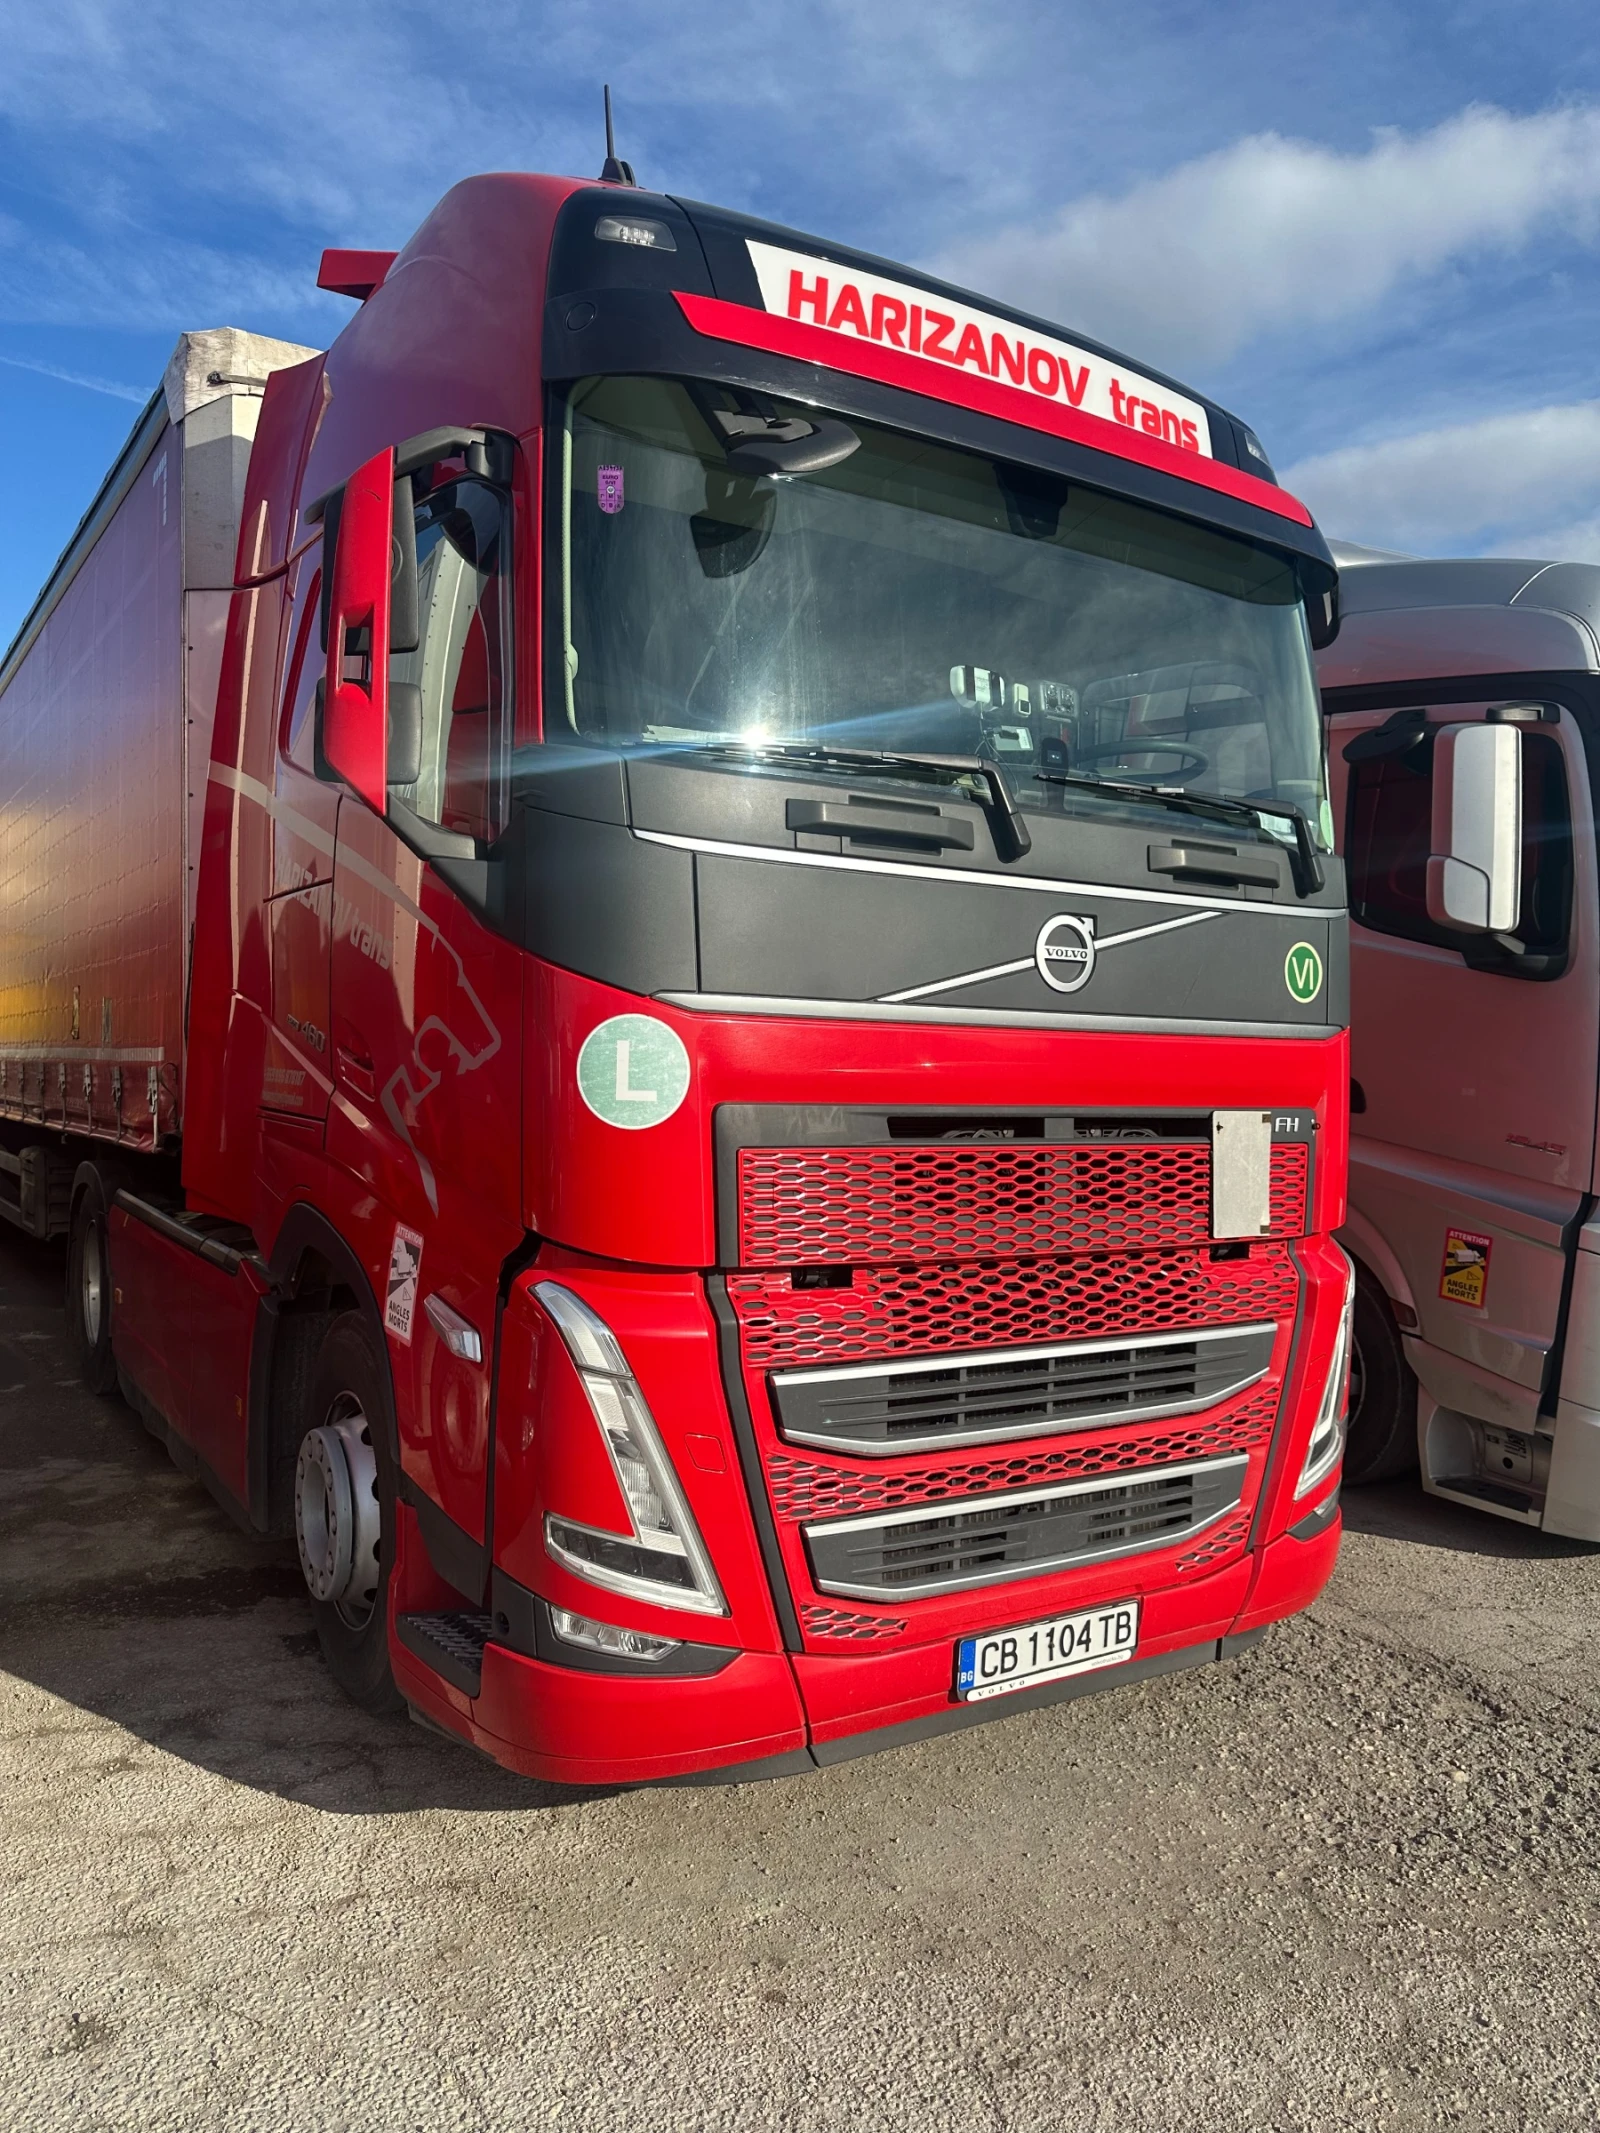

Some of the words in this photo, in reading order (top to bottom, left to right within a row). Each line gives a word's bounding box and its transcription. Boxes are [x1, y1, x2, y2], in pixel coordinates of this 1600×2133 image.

[787, 269, 1090, 406] HARIZANOV
[1109, 378, 1198, 452] trans
[350, 907, 393, 970] trans
[1045, 947, 1088, 959] VOLVO
[1291, 956, 1314, 991] VI
[301, 1020, 326, 1053] 460
[615, 1040, 657, 1101] L
[1275, 1117, 1299, 1132] FH
[397, 1226, 423, 1245] ATTENTION
[1449, 1230, 1490, 1245] ATTENTION
[1446, 1278, 1479, 1293] ANGLES
[1447, 1286, 1476, 1301] MORTS
[388, 1300, 410, 1320] ANGLES
[388, 1312, 408, 1333] MORTS
[981, 1637, 1018, 1678] CB
[1029, 1619, 1091, 1666] 1104
[1099, 1610, 1131, 1649] TB
[961, 1671, 974, 1684] BG
[978, 1680, 1026, 1697] VOLVO
